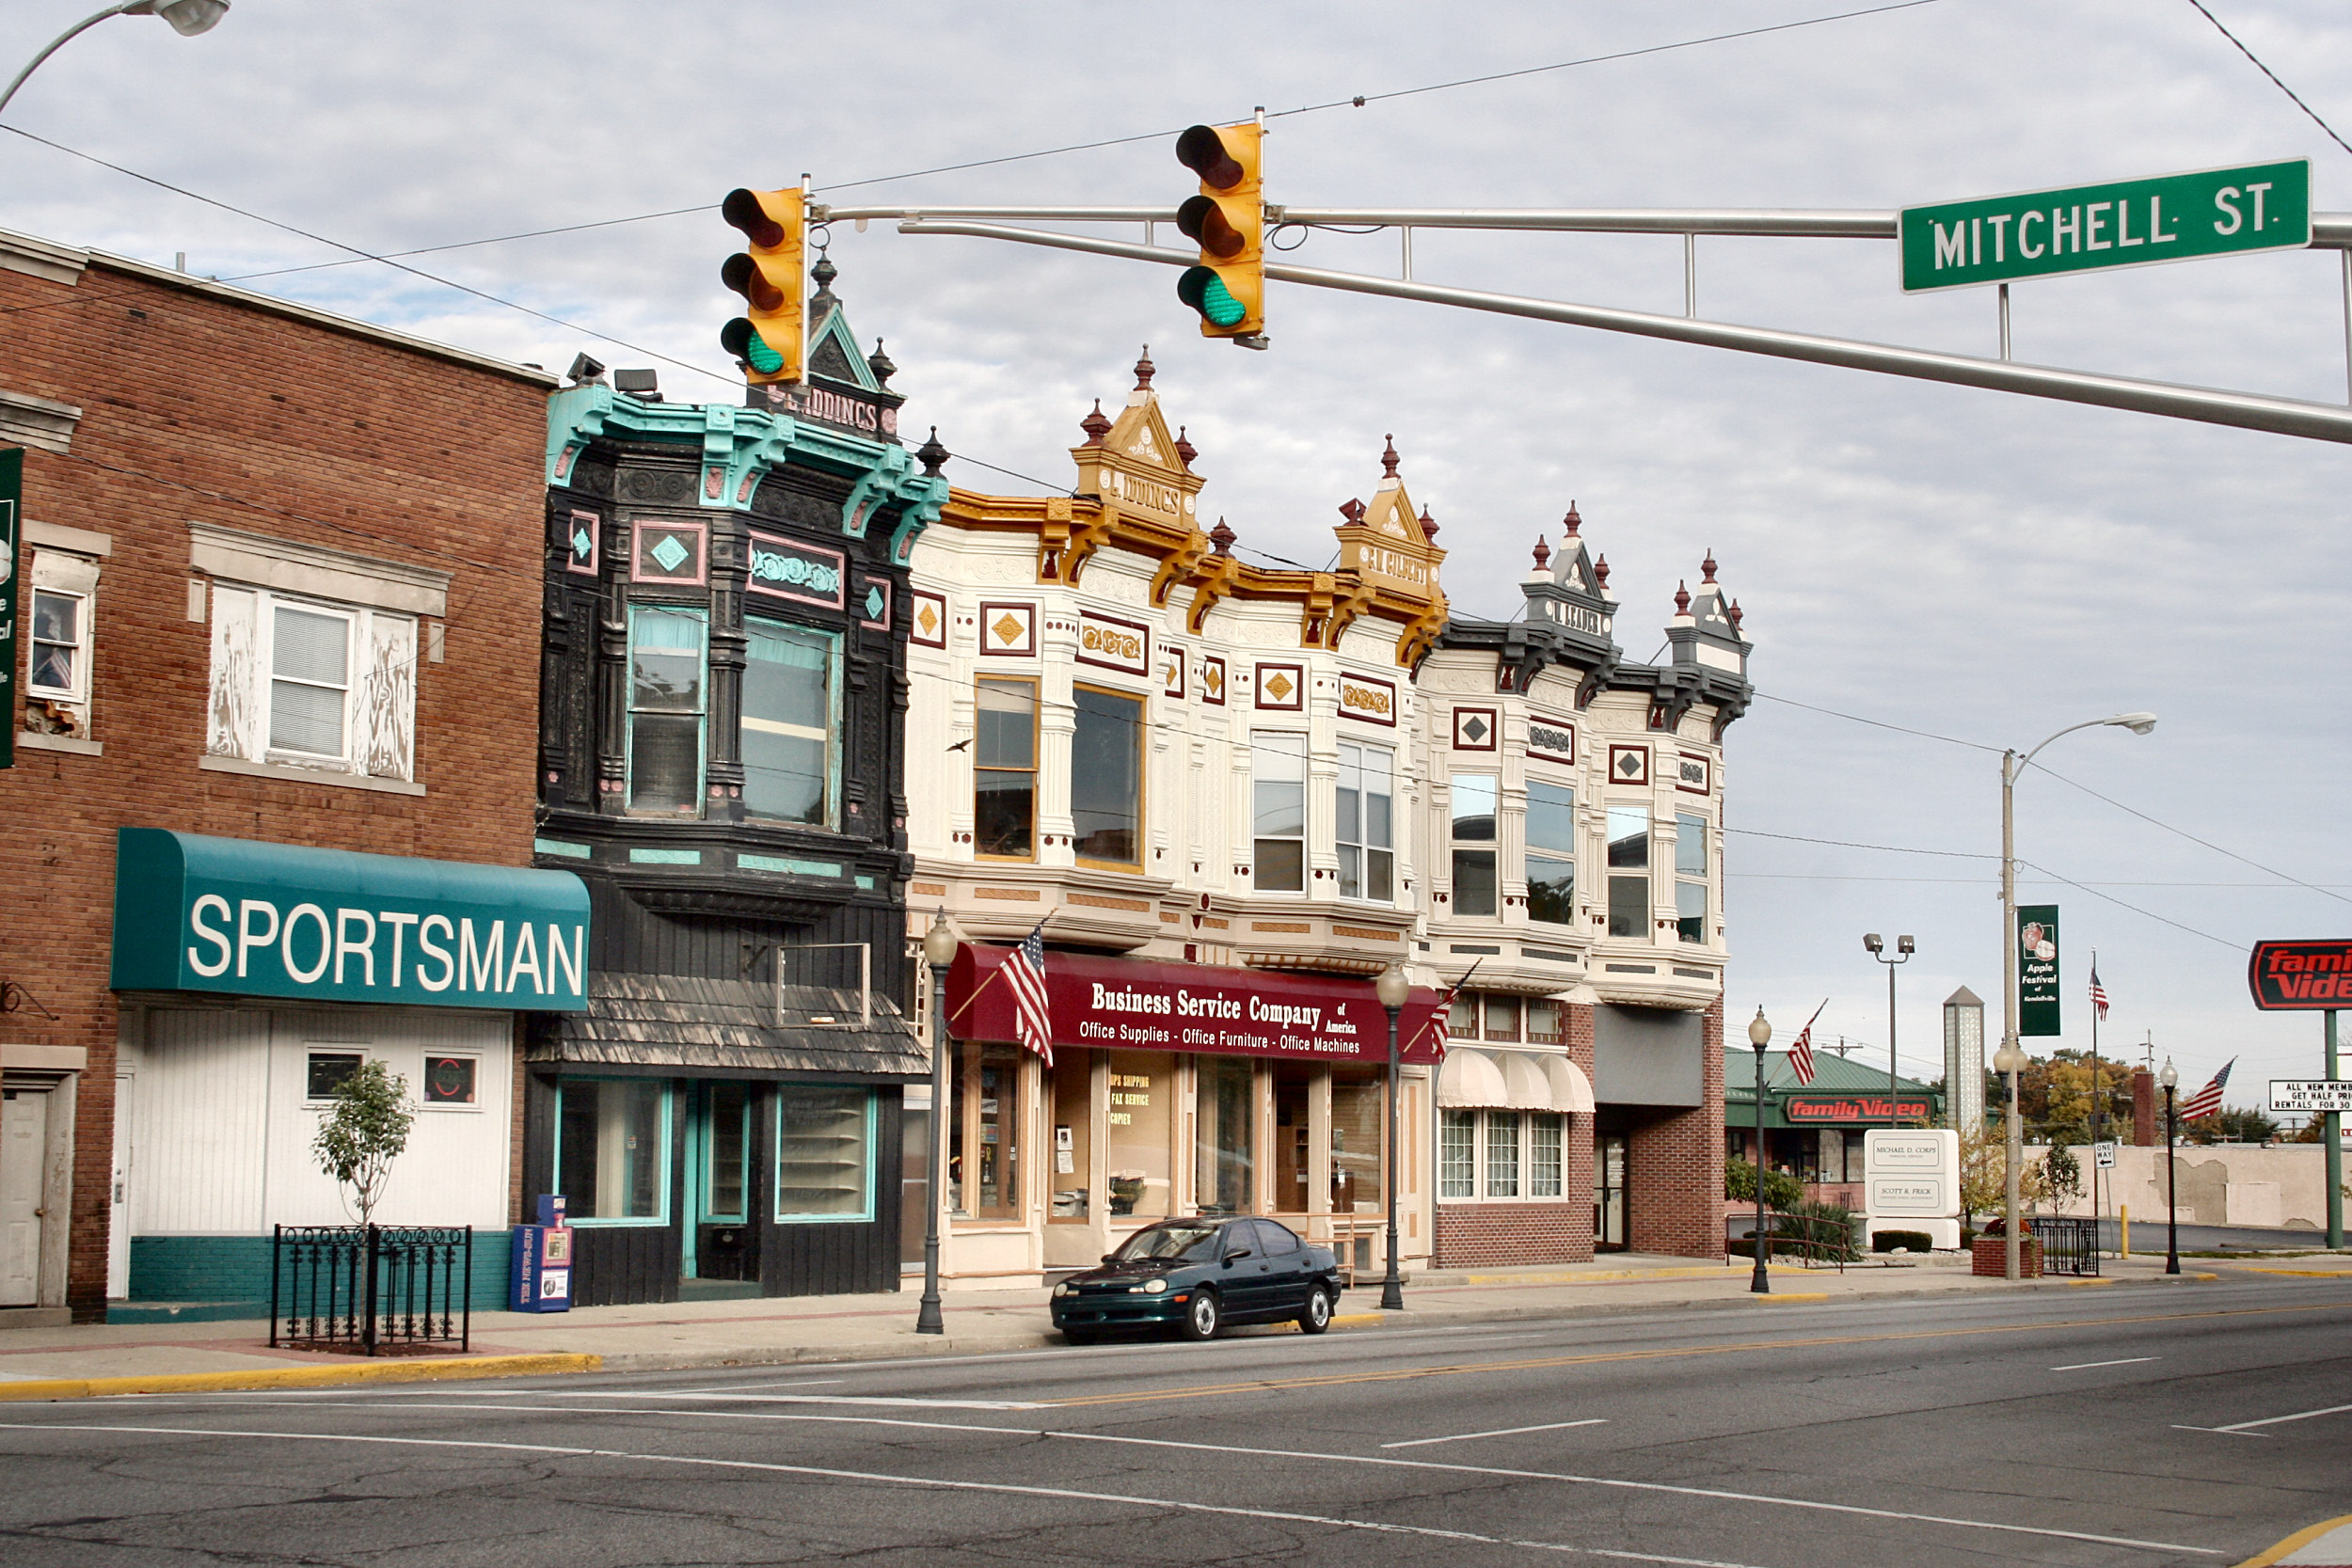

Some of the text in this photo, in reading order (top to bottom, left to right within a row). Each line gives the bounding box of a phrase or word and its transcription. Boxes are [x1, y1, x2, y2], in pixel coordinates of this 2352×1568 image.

[1933, 196, 2177, 271] MITCHELL
[804, 388, 877, 432] IDDINGS
[1123, 475, 1179, 515] IDDINGS
[1387, 552, 1427, 584] GILBERT
[1565, 604, 1598, 634] LEADER
[188, 894, 583, 996] SPORTSMAN
[2027, 962, 2053, 974] Apple
[2022, 974, 2058, 984] Festival
[1091, 982, 1321, 1032] Business Service Company
[1337, 1003, 1346, 1016] of
[1325, 1020, 1358, 1035] America
[1079, 1022, 1116, 1040] Office
[1120, 1024, 1169, 1044] Supplies
[1183, 1028, 1216, 1046] Office
[1219, 1031, 1268, 1049] Furniture
[1279, 1035, 1311, 1052] Office
[1314, 1037, 1360, 1054] Machines
[1122, 1075, 1150, 1087] SHIPPING
[2286, 1083, 2301, 1091] ALL
[2308, 1083, 2324, 1091] NEW
[1111, 1093, 1150, 1106] FAX SERVICE
[2275, 1101, 2350, 1109] RENTALS FOR 30
[1110, 1113, 1131, 1125] COPIES
[520, 1282, 531, 1305] THE
